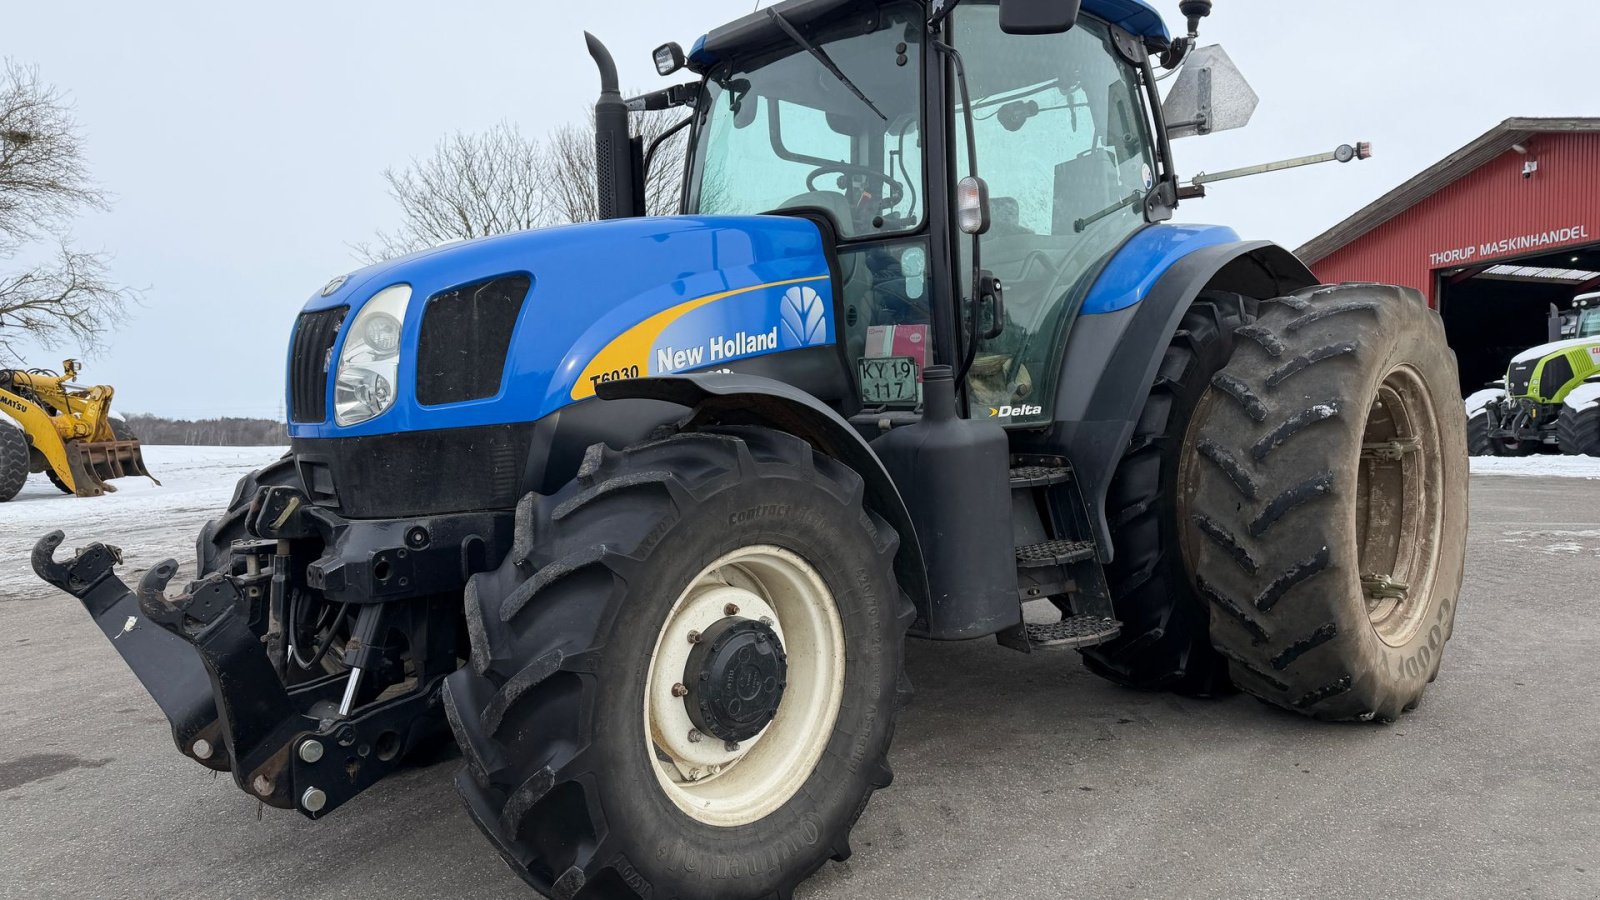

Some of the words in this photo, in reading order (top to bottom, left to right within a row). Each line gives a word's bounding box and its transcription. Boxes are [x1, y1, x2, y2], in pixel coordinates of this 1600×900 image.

[1430, 246, 1476, 265] THORUP
[1479, 225, 1588, 256] MASKINHANDEL
[657, 344, 704, 373] New
[709, 326, 777, 361] Holland
[590, 365, 639, 386] T6030
[862, 362, 884, 379] KY
[891, 361, 911, 379] 19
[874, 382, 904, 399] 117
[0, 396, 27, 413] MATSU
[998, 404, 1042, 418] Delta
